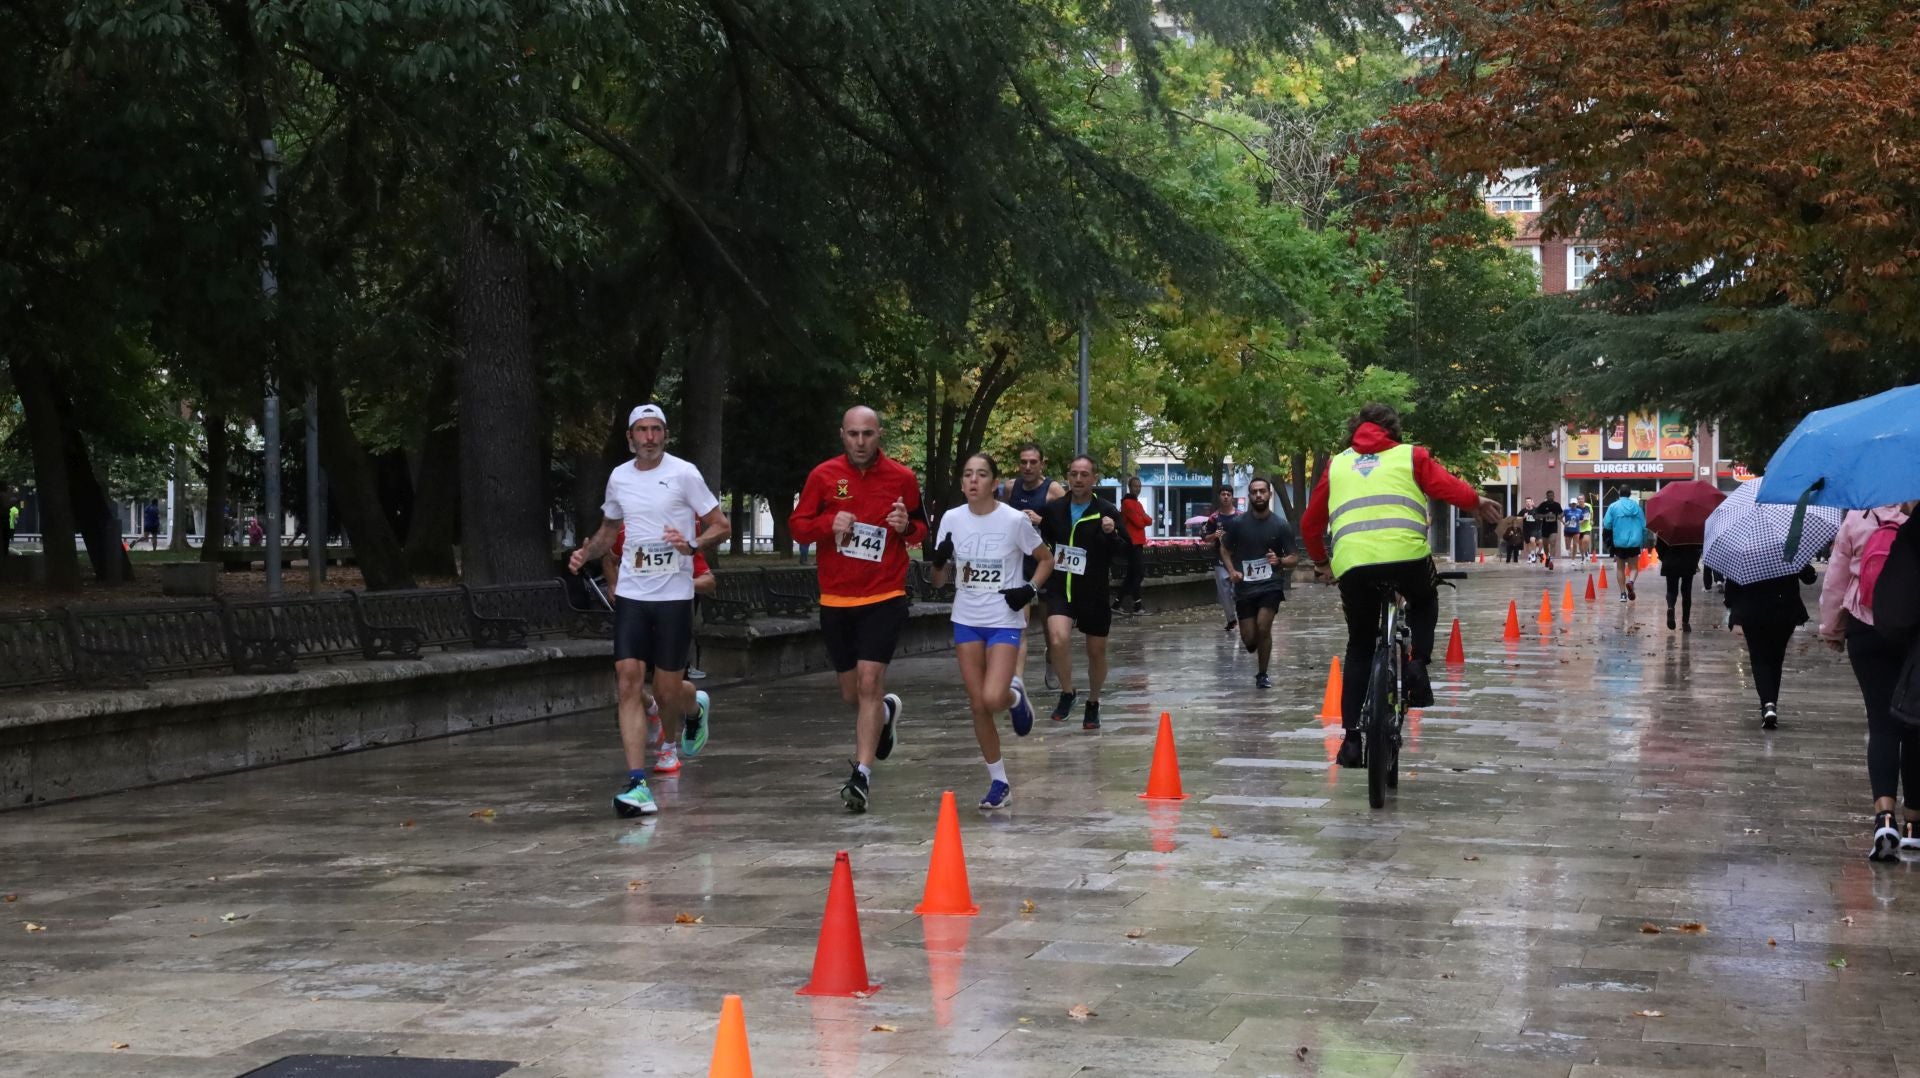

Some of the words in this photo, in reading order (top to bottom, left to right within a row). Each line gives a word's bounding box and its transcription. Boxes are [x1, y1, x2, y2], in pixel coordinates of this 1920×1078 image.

[1593, 463, 1635, 473] BURGER
[1637, 463, 1664, 473] KING
[852, 535, 881, 552] 144
[644, 551, 674, 566] 157
[1066, 555, 1080, 566] 10
[970, 569, 1001, 583] 222
[1254, 565, 1266, 575] 77
